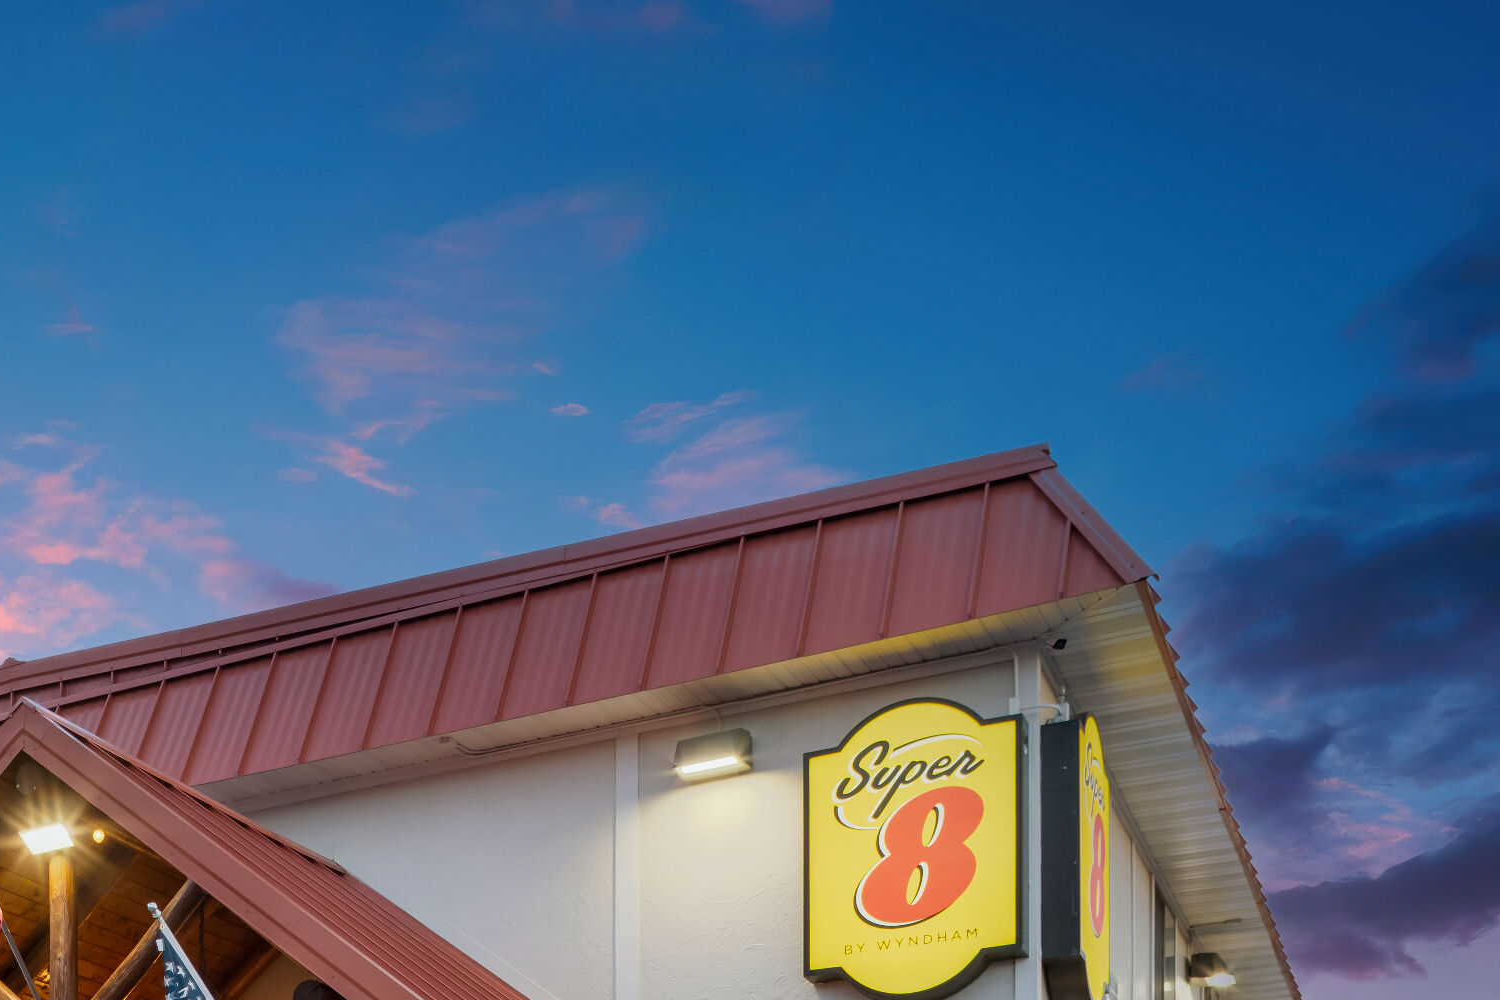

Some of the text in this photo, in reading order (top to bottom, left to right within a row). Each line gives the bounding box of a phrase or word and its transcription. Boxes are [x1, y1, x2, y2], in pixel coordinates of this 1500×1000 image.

[834, 739, 985, 820] Super
[1084, 742, 1106, 817] Super
[854, 785, 985, 928] 8
[1089, 813, 1106, 938] 8
[843, 927, 980, 956] BY WYNDHAM
